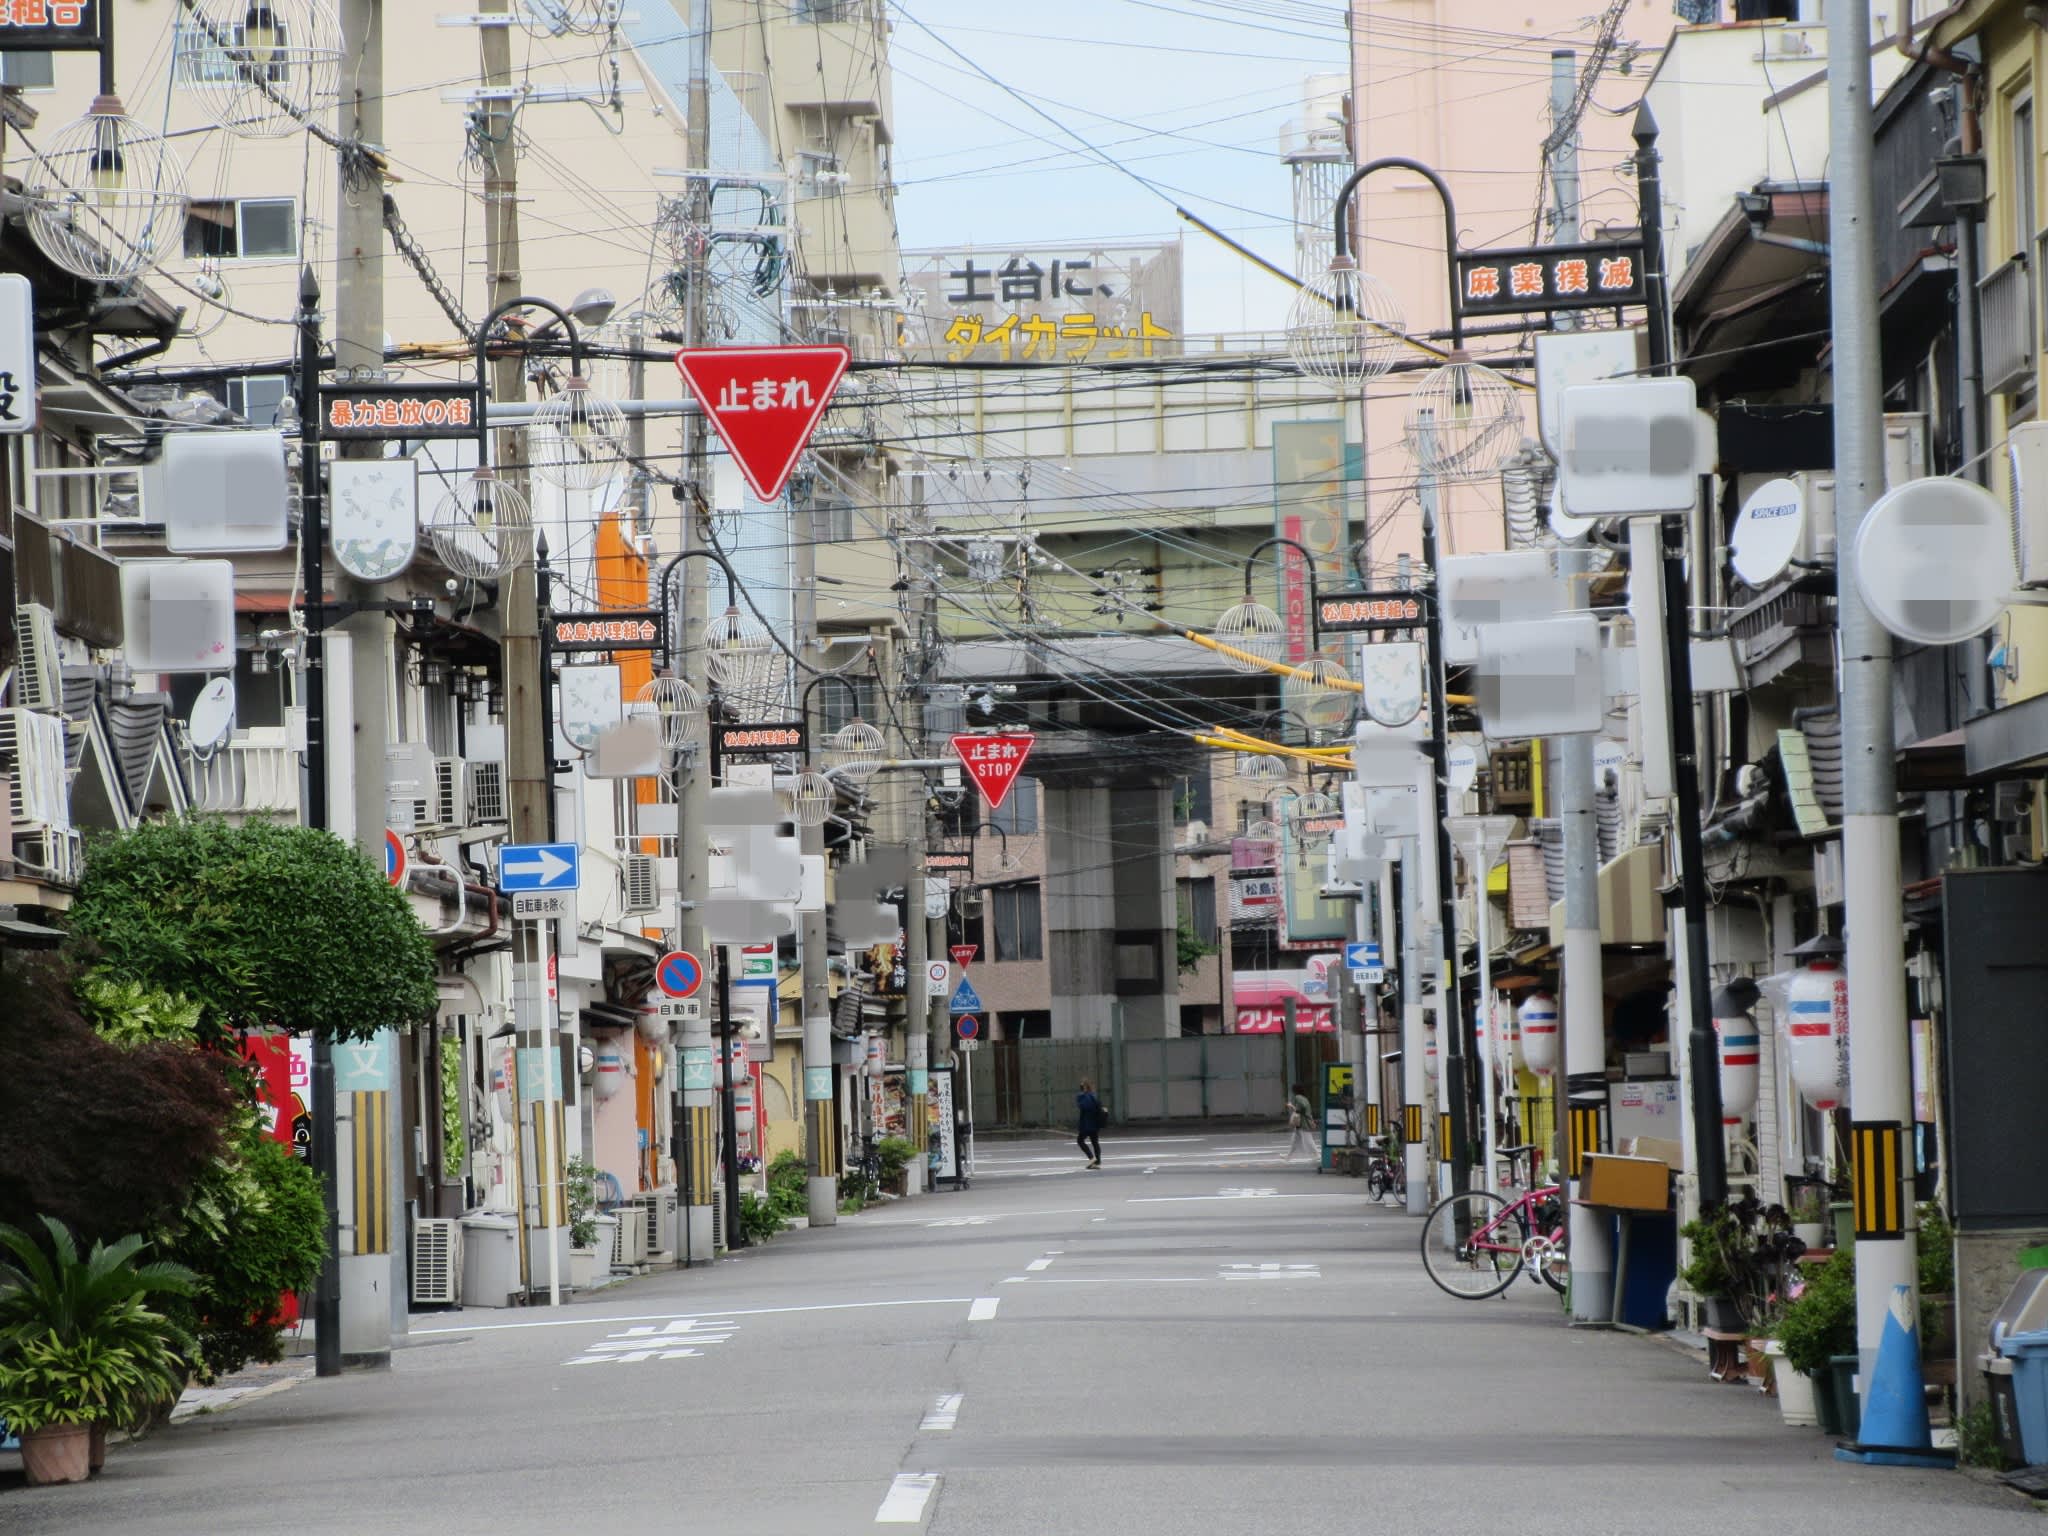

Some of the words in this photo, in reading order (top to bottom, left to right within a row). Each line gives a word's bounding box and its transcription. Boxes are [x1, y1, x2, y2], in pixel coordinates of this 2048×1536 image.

[1468, 257, 1634, 297] 麻薬撲滅
[944, 311, 1175, 362] ダイカラット
[715, 376, 815, 412] 止まれ
[330, 398, 471, 427] 暴力追放の街
[1322, 599, 1419, 622] 松島料理組合
[556, 620, 657, 642] 松島料理組合
[723, 728, 801, 747] 松島料理組合
[969, 743, 1019, 760] 止まれ
[978, 763, 1012, 777] STOP
[660, 1003, 698, 1015] 自動車
